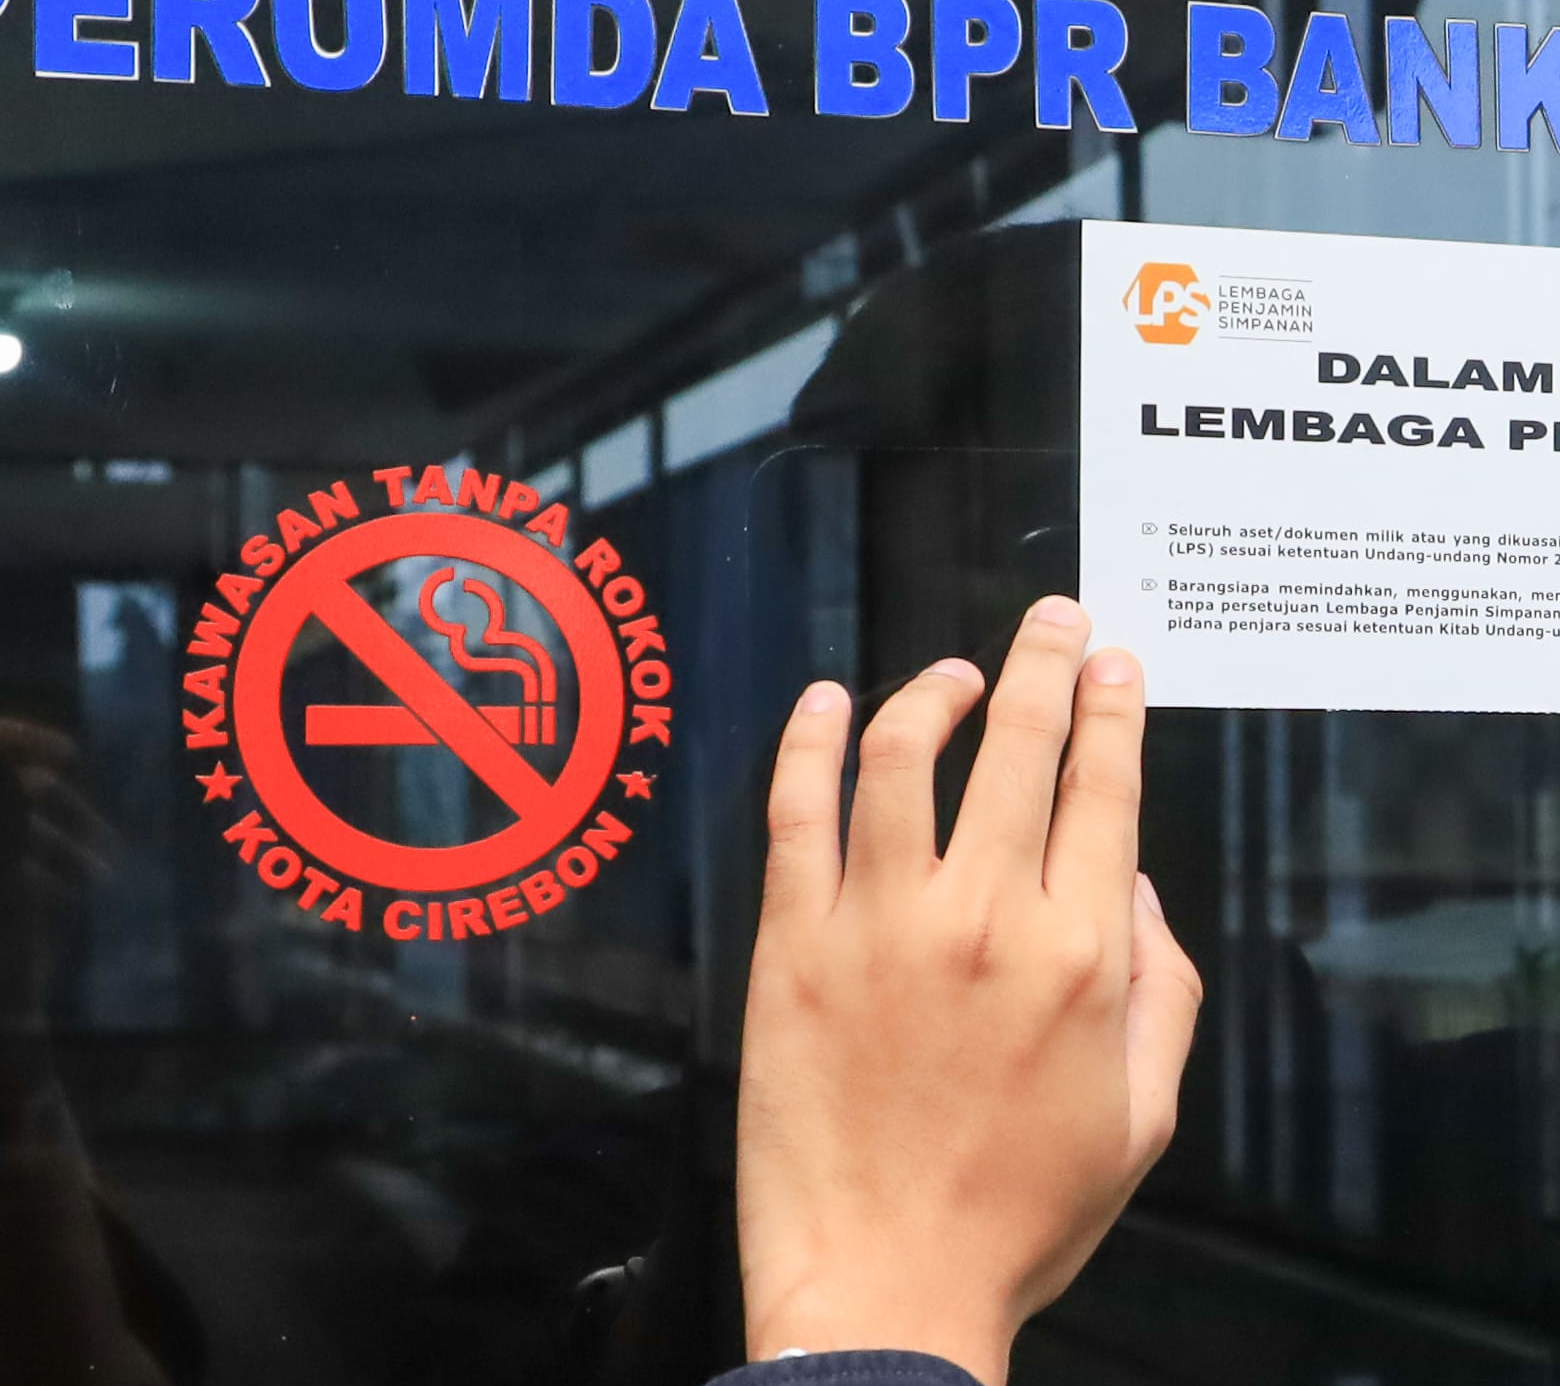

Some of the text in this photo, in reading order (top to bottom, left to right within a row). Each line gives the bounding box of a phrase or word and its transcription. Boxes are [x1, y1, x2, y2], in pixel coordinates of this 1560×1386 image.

[1218, 285, 1306, 301] LEMBAGA
[1218, 299, 1313, 318] PENJAMIN
[1218, 315, 1313, 333] SIMPANAN
[1317, 351, 1554, 395] DALAM
[1140, 402, 1486, 450] LEMBAGA
[1167, 523, 1232, 538] Seluruh
[1239, 526, 1359, 542] aset/dokumen
[1365, 529, 1405, 544] milik
[1411, 531, 1446, 545] atau
[1452, 534, 1491, 549] yang
[1168, 541, 1214, 558] (LPS)
[1219, 543, 1272, 558] sesuai
[1277, 543, 1360, 560] ketentuan
[1365, 547, 1492, 567] Undang-undang
[1496, 551, 1549, 566] Nomor
[1168, 578, 1270, 598] Barangsiapa
[1278, 582, 1398, 600] memindahkan,
[1406, 586, 1523, 603] menggunakan,
[181, 464, 673, 750] KAWASAN TANPA ROKOK
[1167, 597, 1215, 614] tanpa
[1220, 599, 1320, 616] persetujuan
[1326, 601, 1399, 619] Lembaga
[1404, 603, 1479, 620] Penjamin
[1167, 615, 1223, 632] pidana
[1228, 617, 1291, 635] penjara
[1296, 619, 1348, 633] sesuai
[1353, 620, 1434, 635] ketentuan
[1439, 622, 1480, 636] Kitab
[222, 809, 634, 942] KOTA CIREBON
